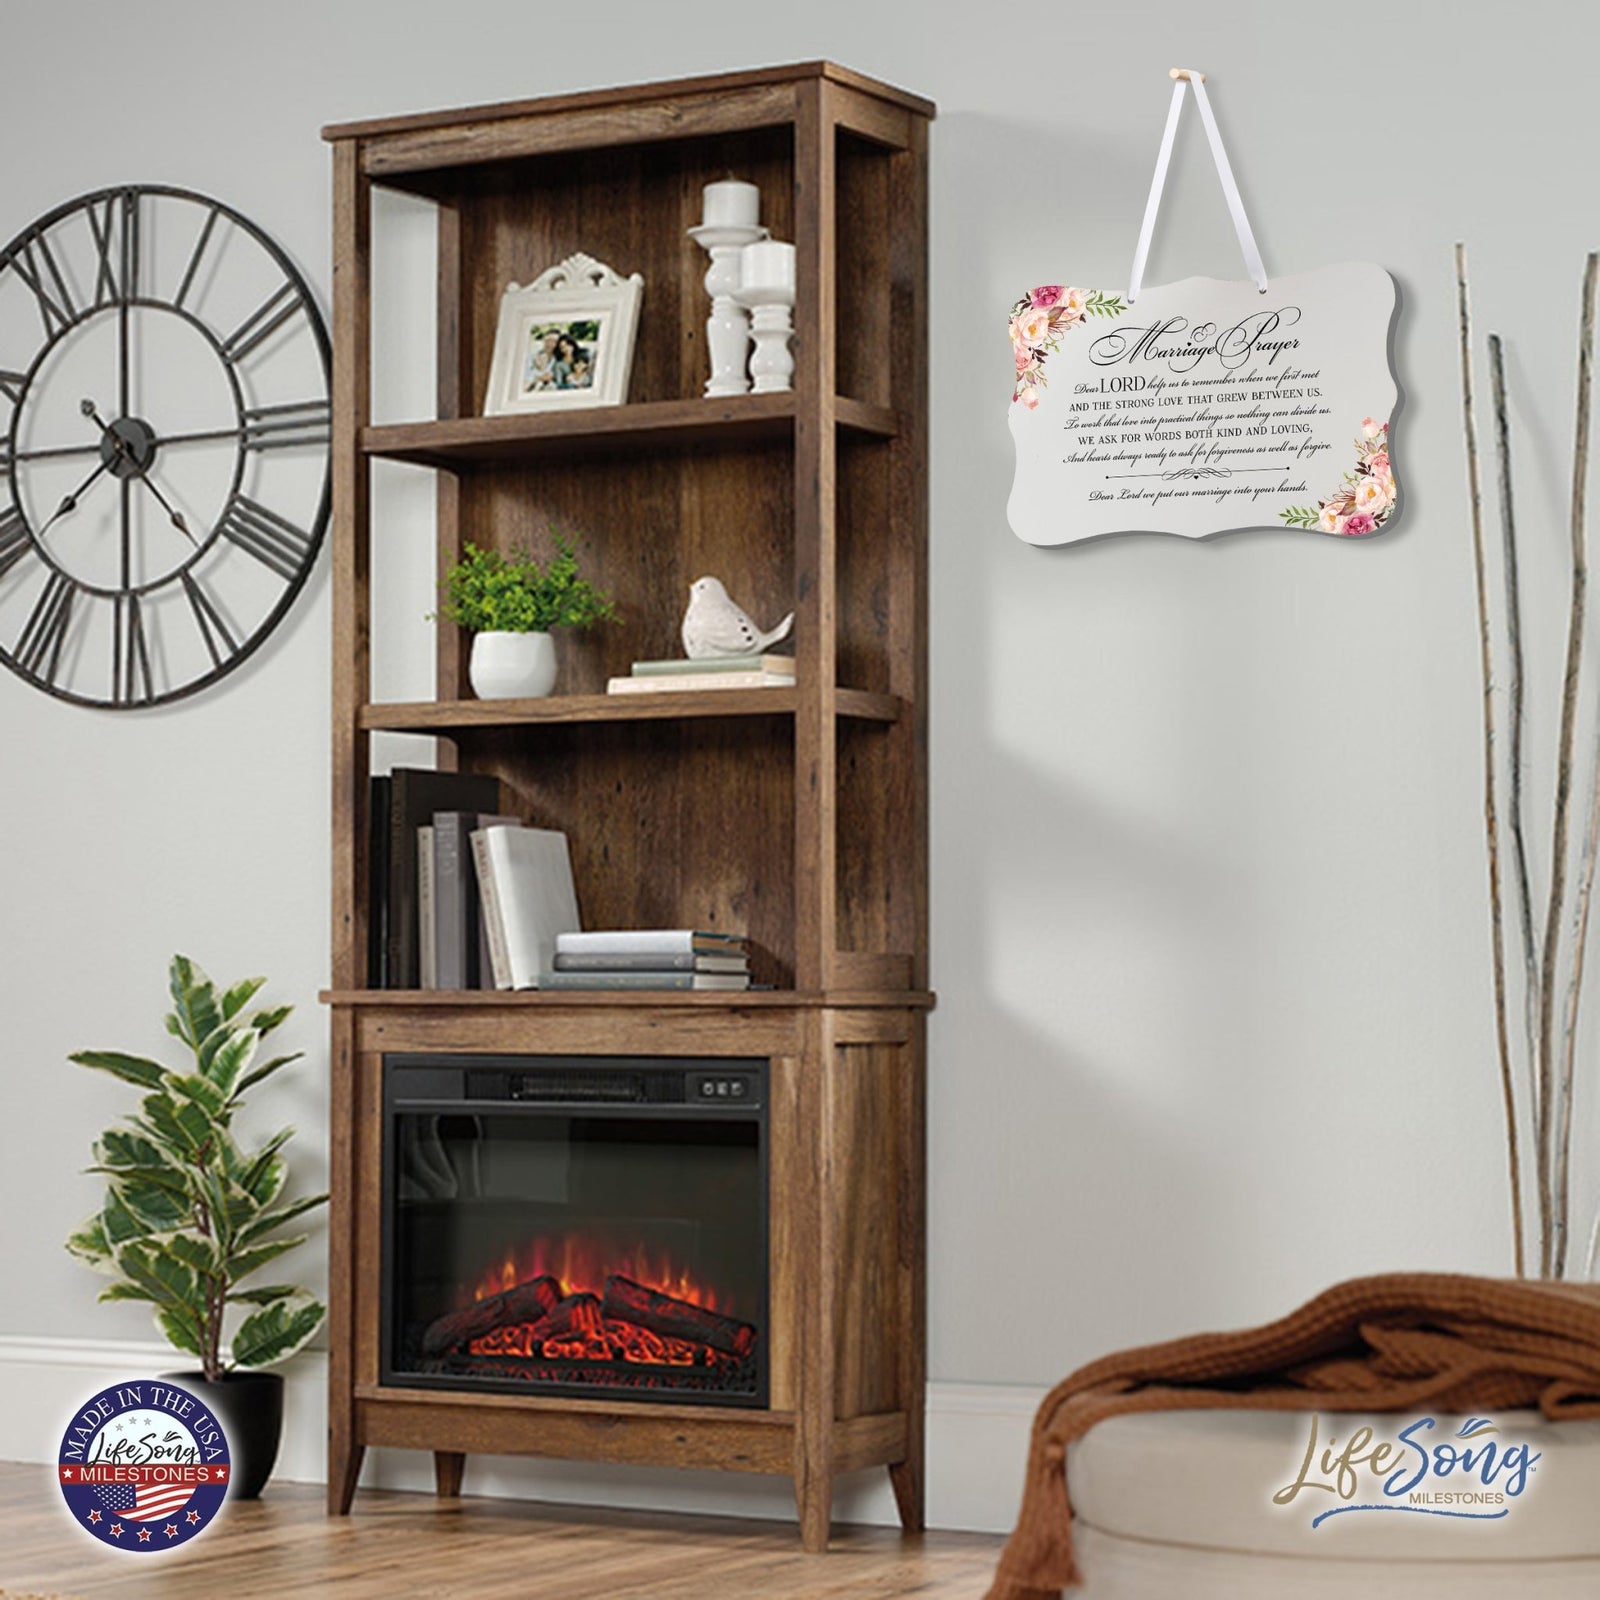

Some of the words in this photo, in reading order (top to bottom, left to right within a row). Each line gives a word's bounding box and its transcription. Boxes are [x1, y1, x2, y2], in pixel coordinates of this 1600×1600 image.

[1089, 316, 1217, 373] Marriage
[1215, 306, 1301, 369] Prayer
[1073, 383, 1099, 394] Dear
[1100, 375, 1146, 394] LORD
[1147, 375, 1166, 397] help
[1181, 379, 1191, 387] to
[1192, 370, 1236, 386] remember
[1238, 368, 1263, 383] when
[1275, 366, 1301, 389] first
[1301, 370, 1320, 379] met
[1069, 402, 1090, 412] AND
[1092, 401, 1112, 411] THE
[1115, 398, 1155, 410] STRONG
[1158, 396, 1183, 407] LOVE
[1187, 395, 1213, 405] THAT
[1216, 392, 1248, 403] GREW
[1251, 389, 1303, 401] BETWEEN
[1307, 387, 1323, 397] US.
[1063, 416, 1080, 430] To
[1081, 413, 1106, 429] work
[1103, 413, 1121, 427] that
[1121, 415, 1139, 426] love
[1140, 416, 1157, 425] into
[1154, 411, 1198, 432] practical
[1196, 407, 1223, 430] things
[1236, 404, 1270, 426] nothing
[1272, 410, 1289, 418] can
[1290, 404, 1317, 416] divide
[1078, 436, 1095, 446] WE
[1098, 434, 1118, 444] ASK
[1121, 433, 1141, 443] FOR
[1144, 430, 1182, 441] WORDS
[1185, 429, 1213, 440] BOTH
[1217, 427, 1242, 438] KIND
[1245, 426, 1268, 436] AND
[1271, 423, 1313, 435] LOVING,
[1062, 451, 1089, 463] And
[1086, 448, 1111, 462] hearts
[1112, 449, 1142, 468] always
[1144, 447, 1167, 467] ready
[1168, 449, 1177, 457] to
[1178, 443, 1198, 457] ask
[1190, 442, 1207, 465] for
[1204, 441, 1255, 464] forgiveness
[1268, 440, 1290, 452] well
[1296, 436, 1332, 459] forgive.
[1088, 490, 1114, 501] Dear
[1117, 488, 1145, 500] Lord
[1151, 489, 1174, 506] put
[1191, 487, 1232, 503] marriage
[1233, 485, 1252, 494] into
[1252, 487, 1276, 502] your
[1277, 478, 1308, 492] hands.
